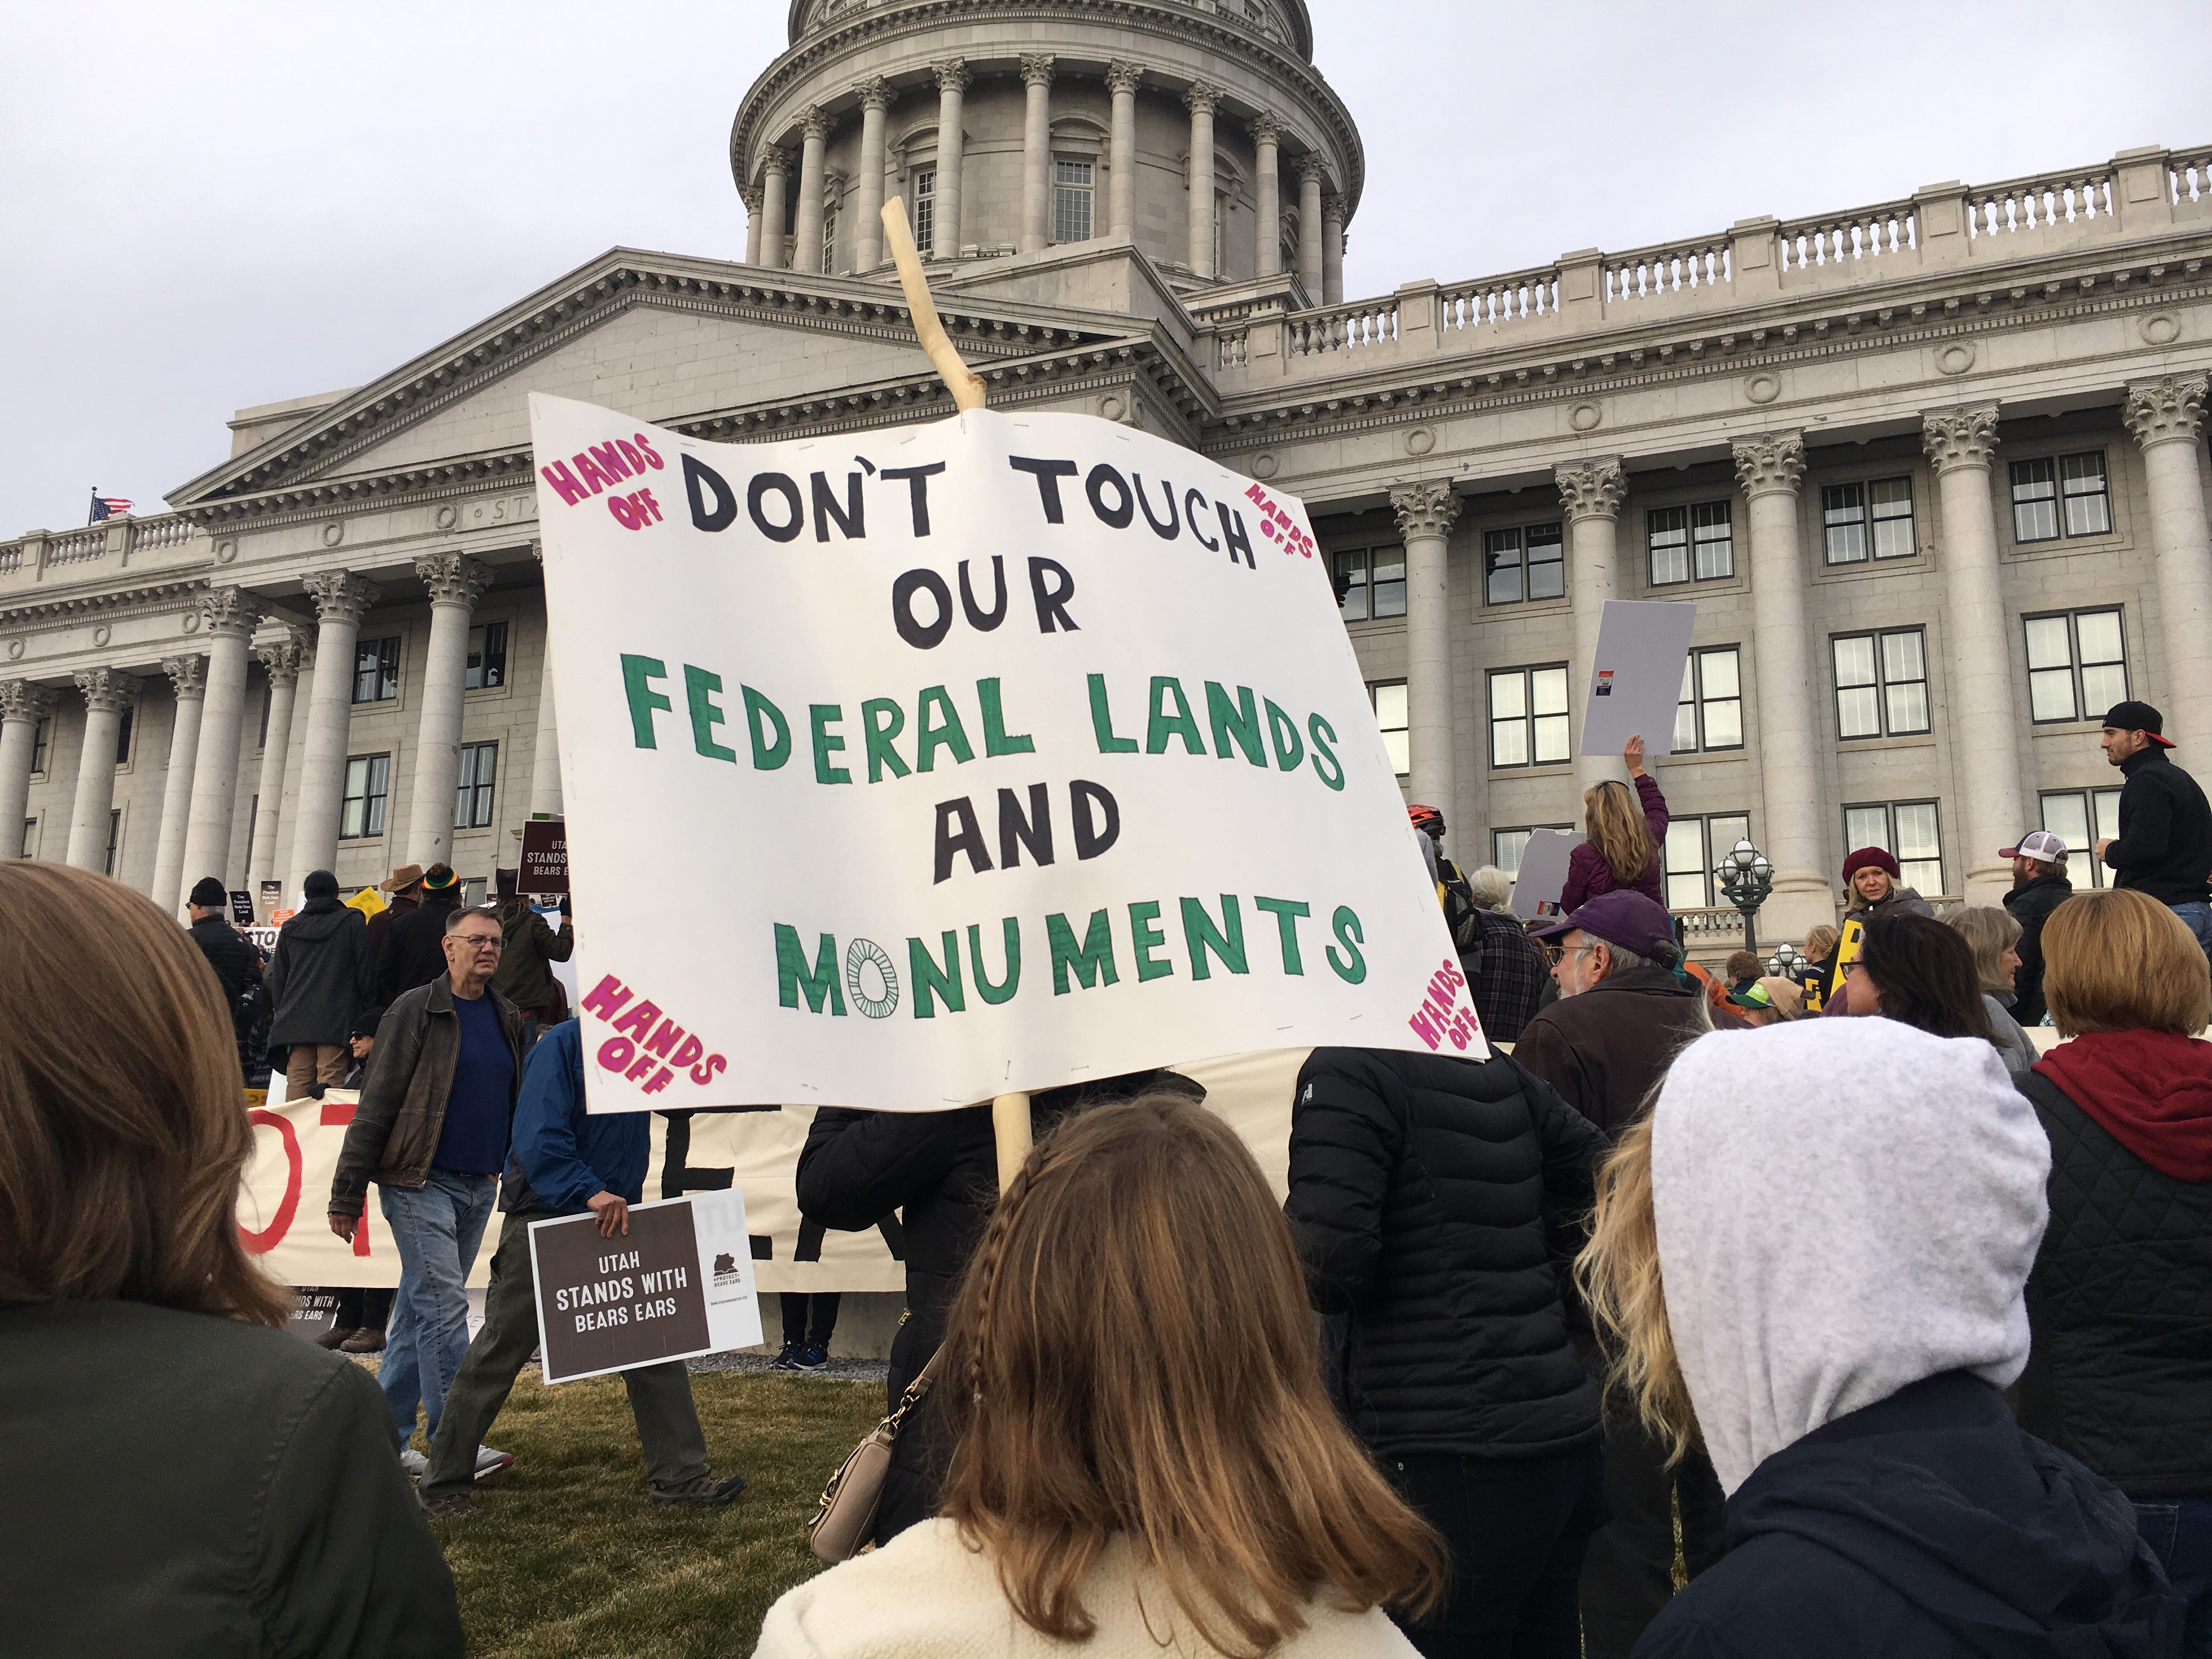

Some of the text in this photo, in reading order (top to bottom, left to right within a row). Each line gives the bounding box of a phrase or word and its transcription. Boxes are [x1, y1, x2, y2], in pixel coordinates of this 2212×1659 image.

[541, 433, 664, 506] HANDS
[607, 488, 664, 531] OFF
[681, 453, 1256, 570] DON'T TOUCH
[1244, 483, 1313, 559] HANDS
[1260, 519, 1295, 556] OFF
[893, 555, 1081, 650] OUR
[620, 653, 1345, 791] FEDERAL LANDS
[934, 780, 1120, 885] AND
[527, 852, 567, 864] STANDS
[533, 866, 561, 876] BEARS
[774, 894, 1368, 1018] MONUMENTS
[1408, 959, 1465, 1052] HANDS
[580, 974, 727, 1086] HANDS
[1448, 1006, 1479, 1051] OFF
[596, 1036, 675, 1096] OFF
[599, 1250, 640, 1274] UTAH
[716, 1273, 737, 1282] PROTECT
[313, 1295, 335, 1307] WITH
[556, 1267, 687, 1311] STANDS WITH
[304, 1310, 324, 1321] EARS
[575, 1297, 676, 1333] BEARS EARS
